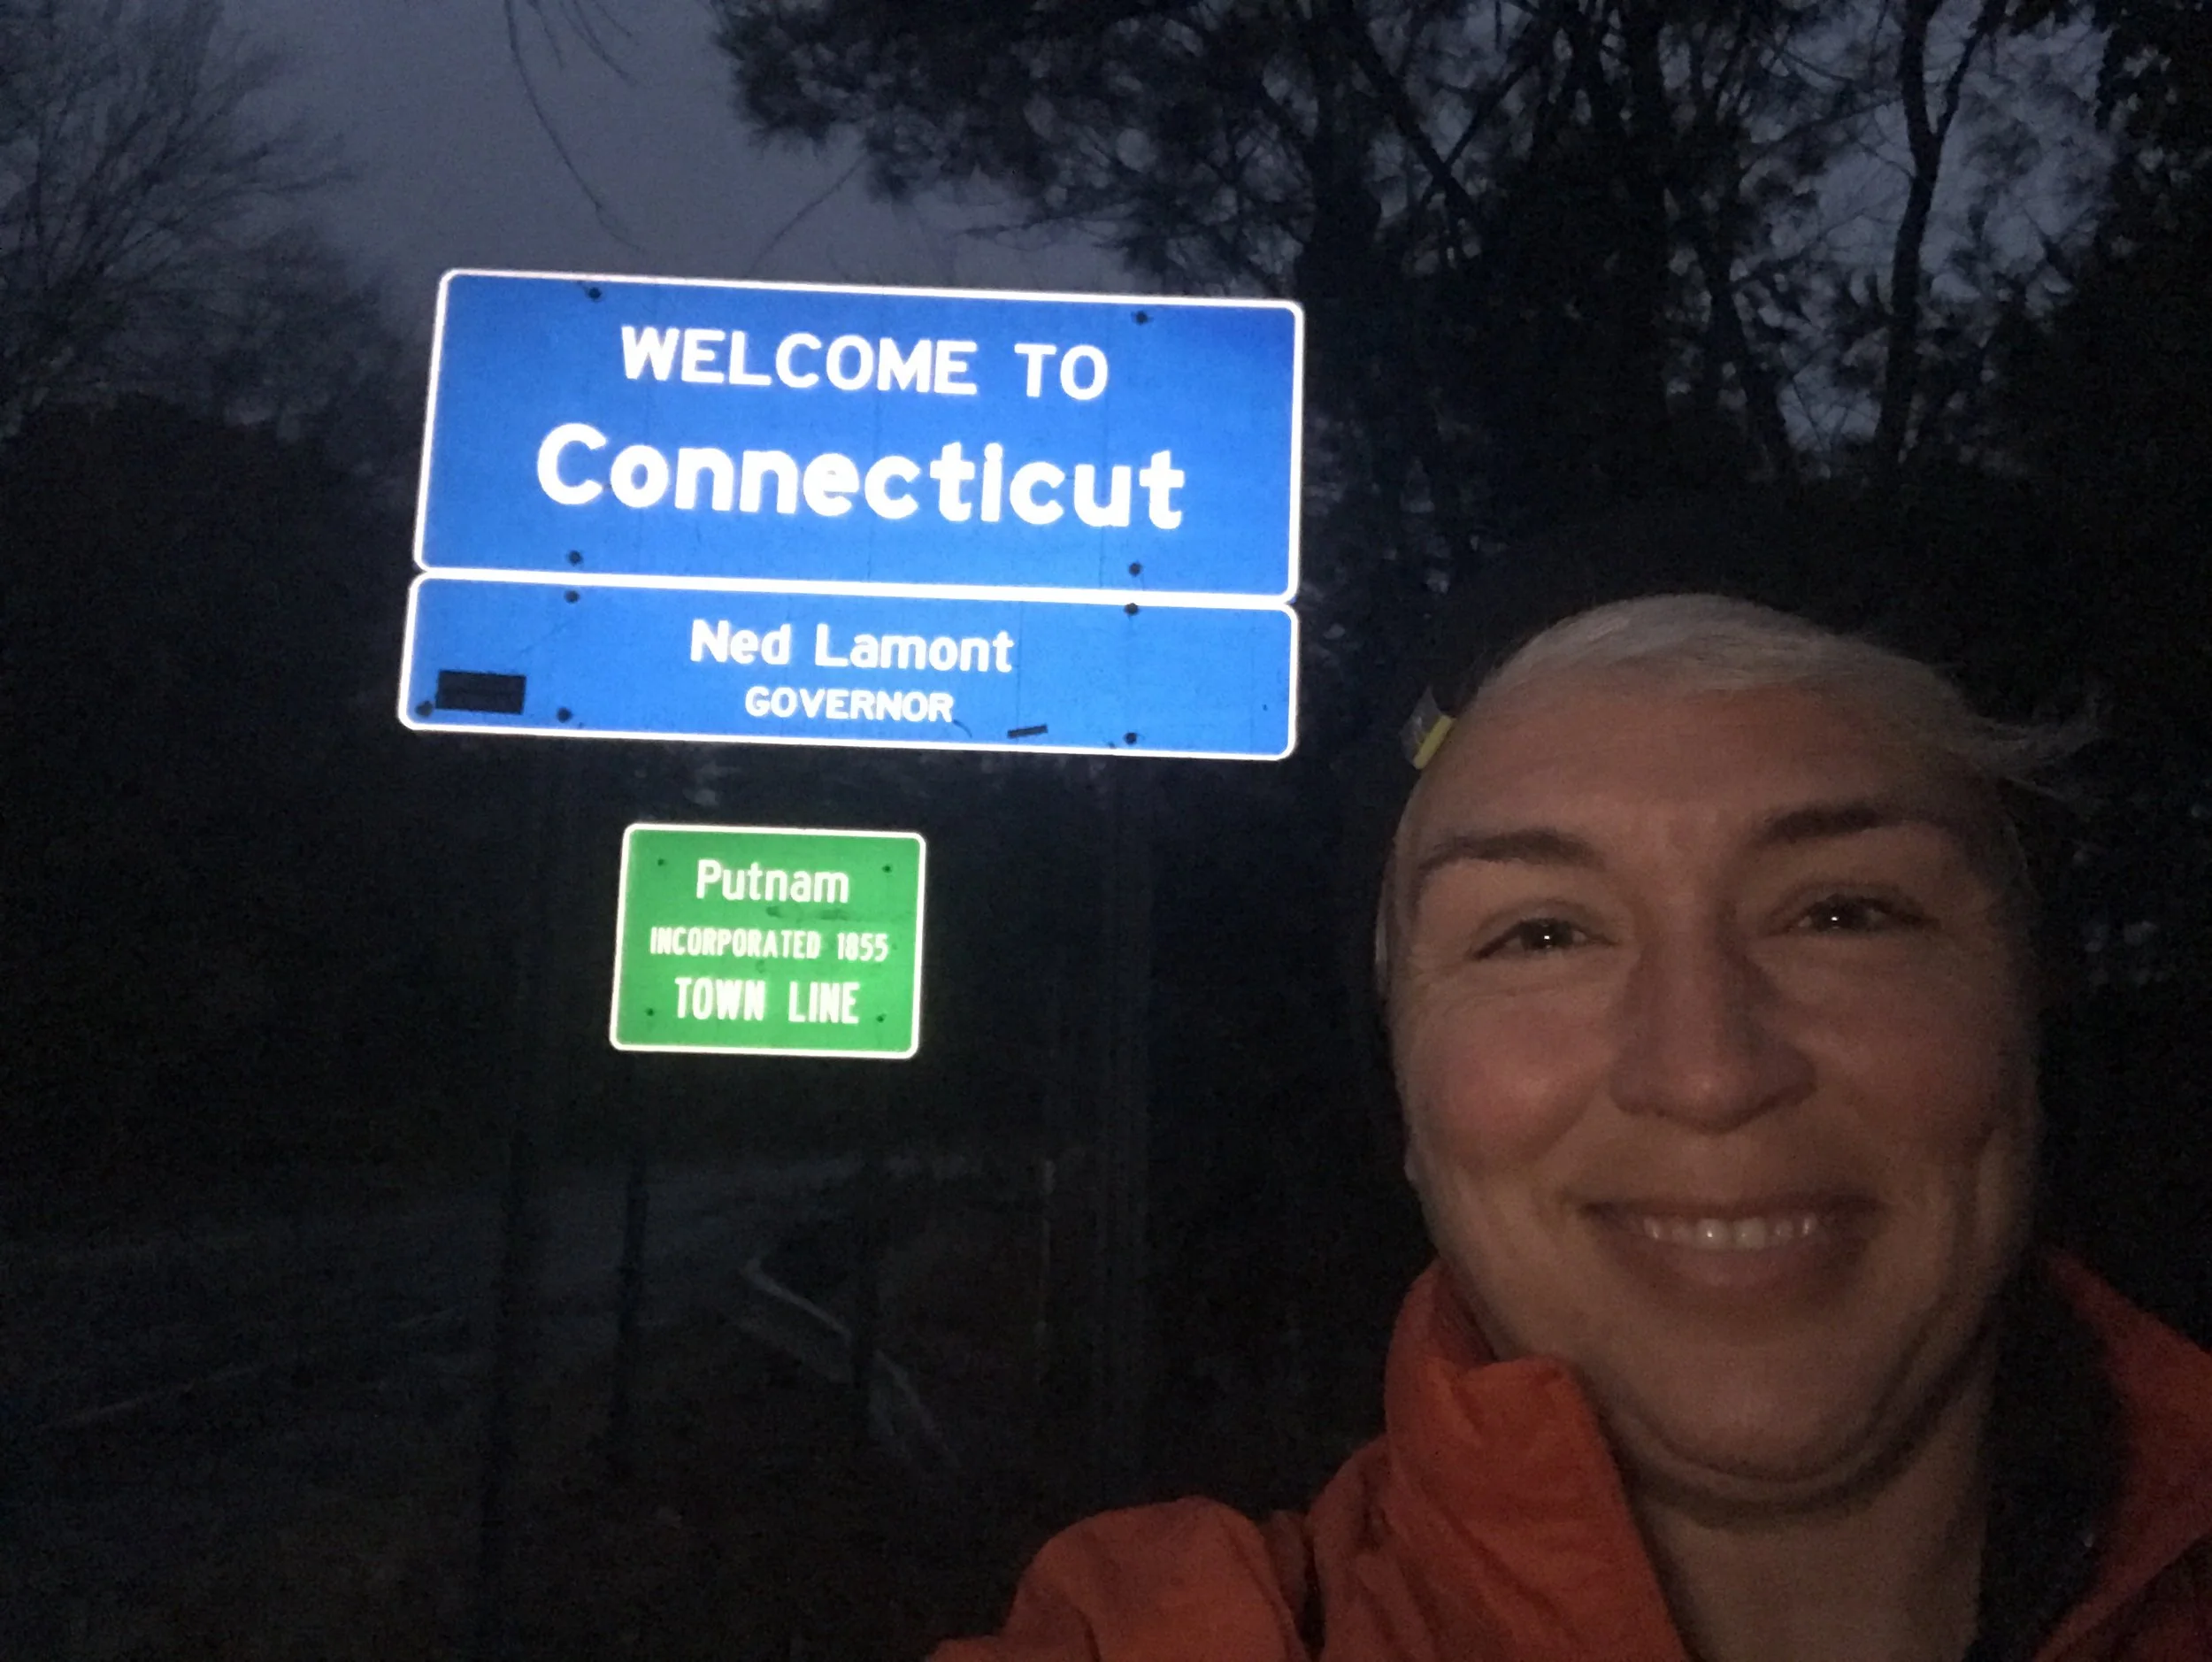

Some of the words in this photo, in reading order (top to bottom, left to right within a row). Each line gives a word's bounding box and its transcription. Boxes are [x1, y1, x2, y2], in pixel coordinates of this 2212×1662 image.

[621, 325, 978, 396] WELCOME
[1014, 342, 1109, 401] TO
[536, 422, 1186, 530] Connecticut
[690, 619, 792, 666] Ned
[814, 622, 1015, 673] Lamont
[745, 685, 955, 723] GOVERNOR
[695, 858, 849, 904] Putnam
[649, 927, 822, 959] INCORPORATED
[837, 932, 889, 962] 1855
[674, 977, 766, 1021] TOWN
[788, 981, 860, 1024] LINE
